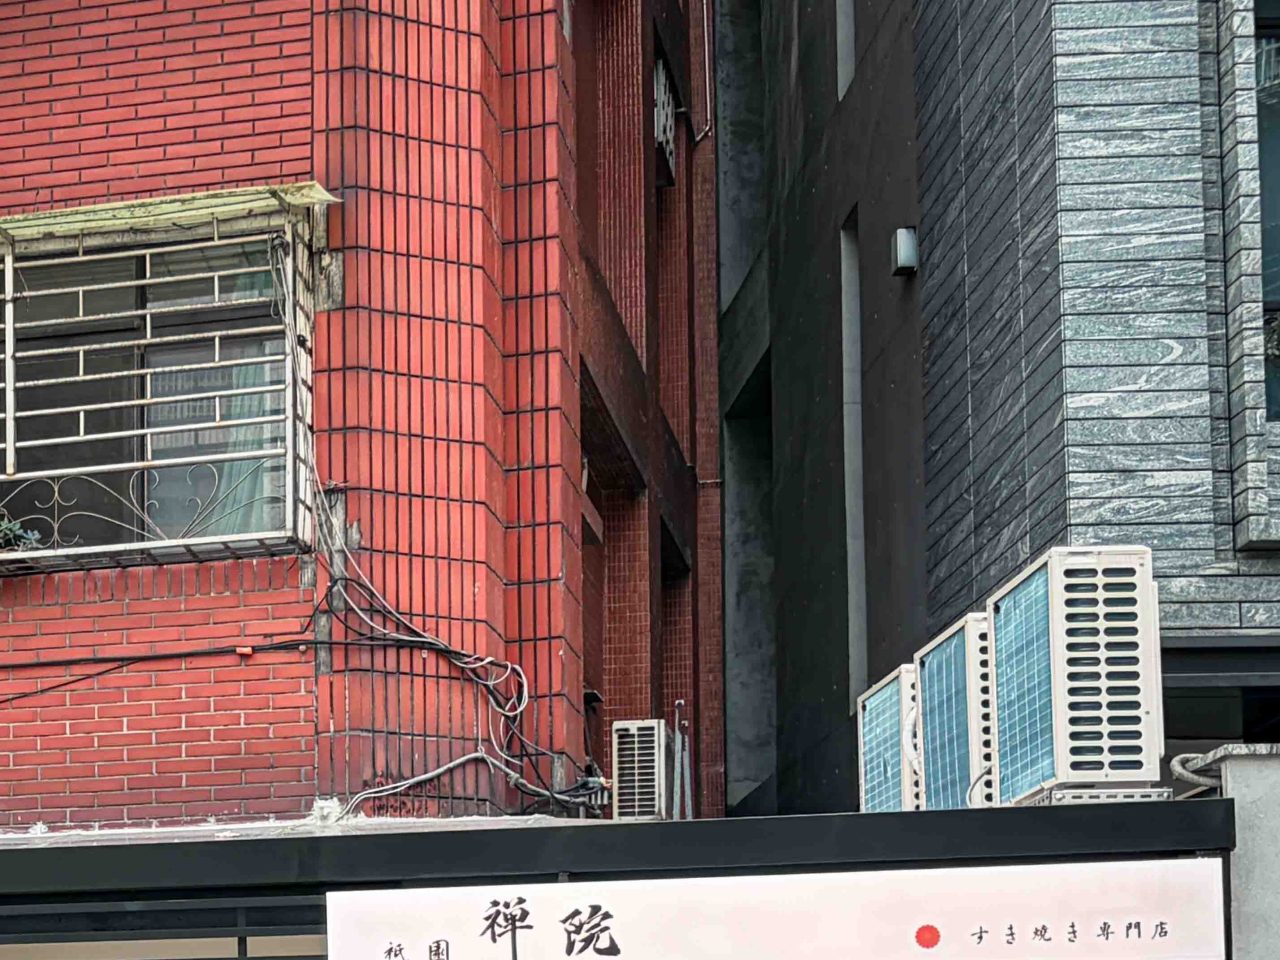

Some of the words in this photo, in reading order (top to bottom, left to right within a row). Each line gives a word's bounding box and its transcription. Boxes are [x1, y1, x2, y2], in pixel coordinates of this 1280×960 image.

[970, 920, 1169, 945] すき焼き専門店
